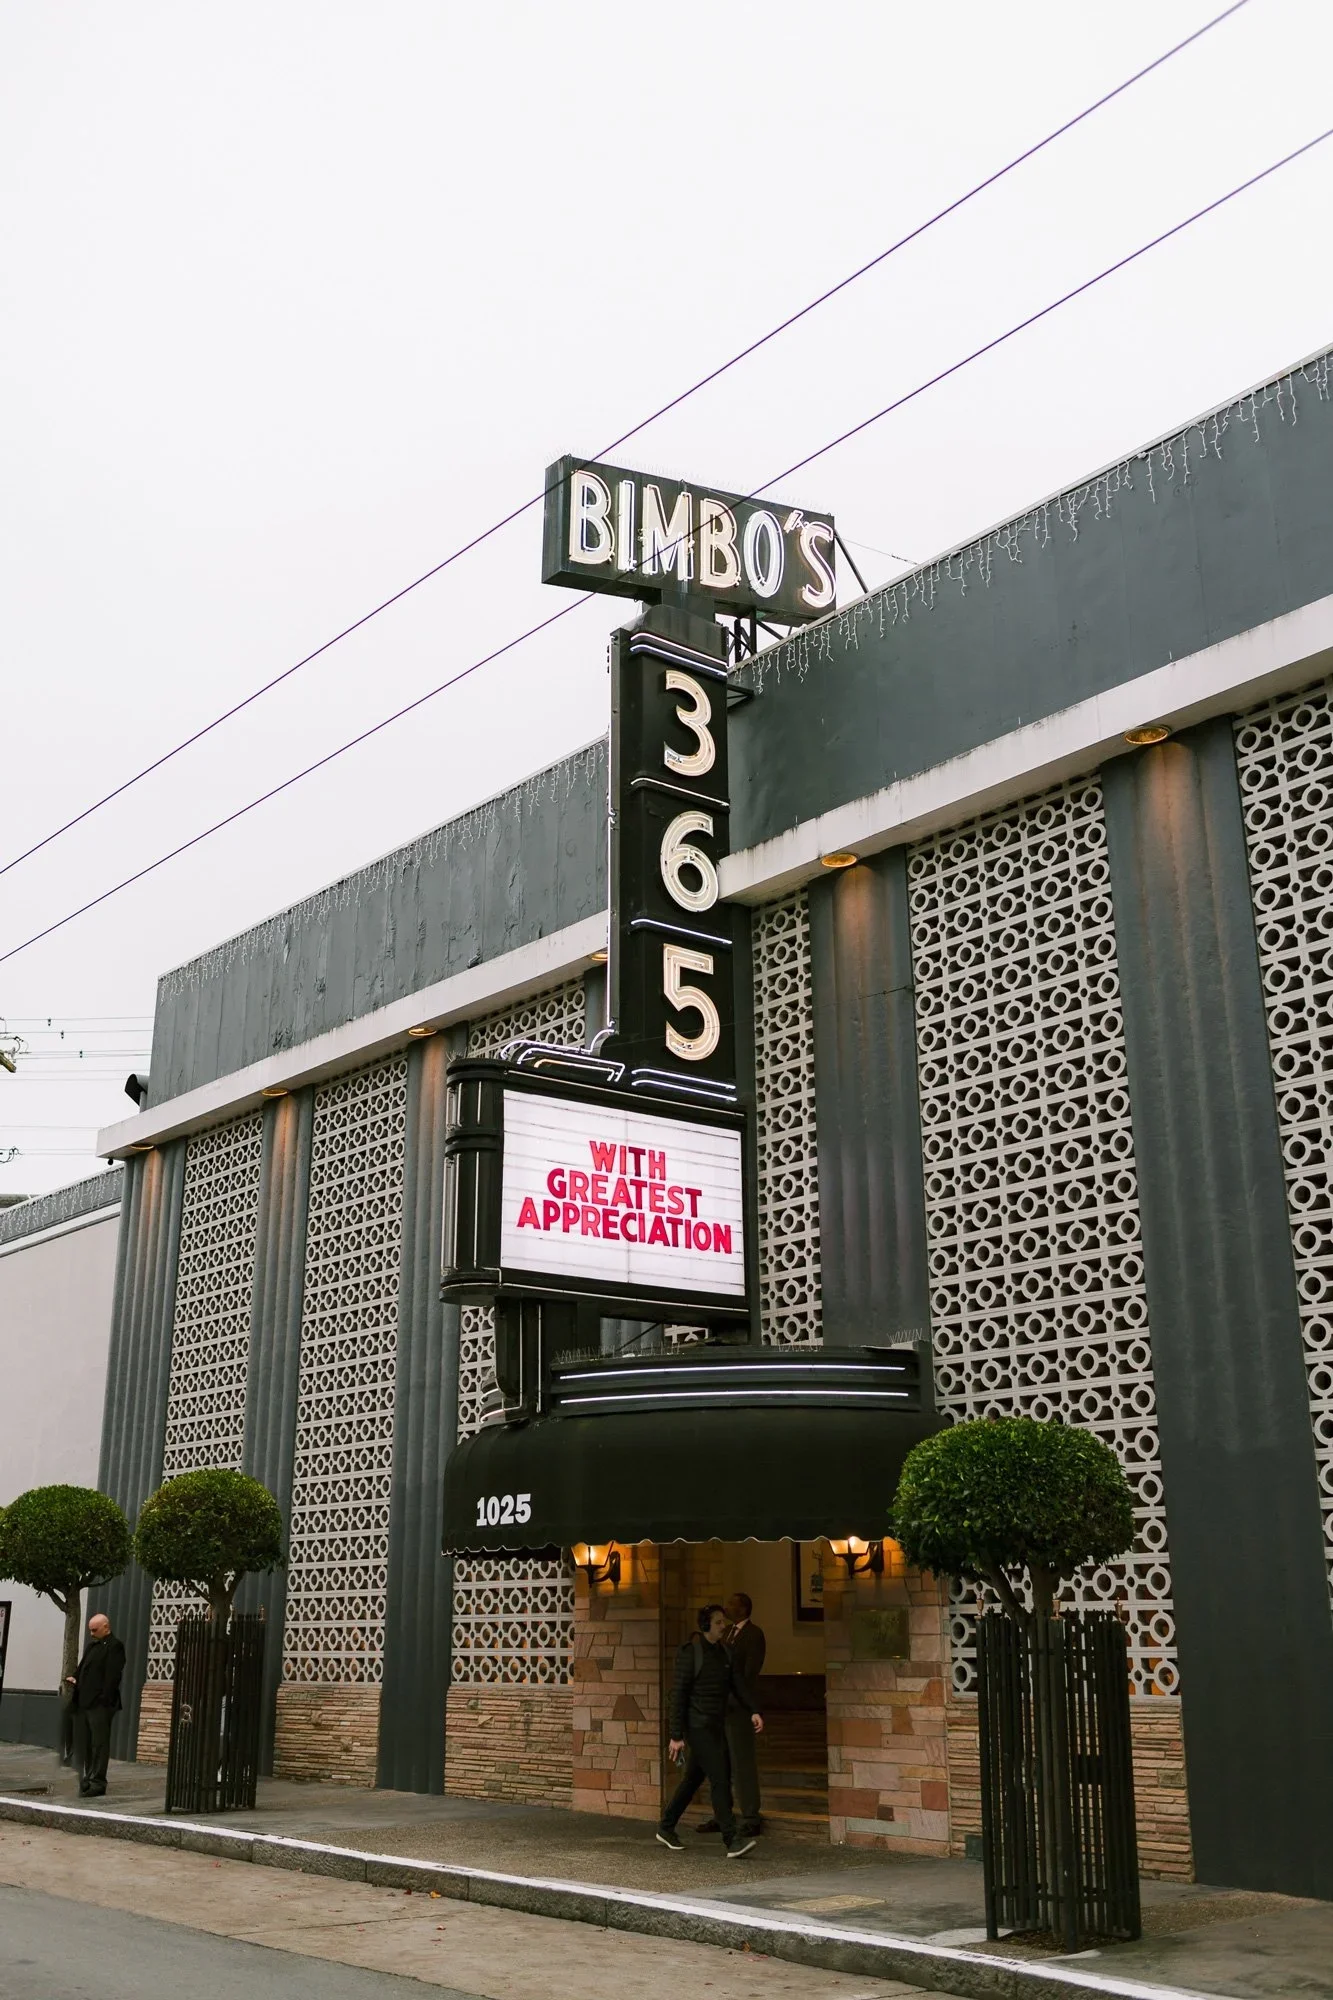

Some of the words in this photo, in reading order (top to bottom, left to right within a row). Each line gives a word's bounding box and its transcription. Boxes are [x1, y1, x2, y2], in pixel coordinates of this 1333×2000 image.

[569, 468, 837, 607] BIMBO'S
[660, 669, 720, 1061] 365
[589, 1140, 666, 1181] WITH
[547, 1168, 702, 1218] GREATEST
[516, 1196, 732, 1254] APPRECIATION
[476, 1493, 531, 1527] 1025
